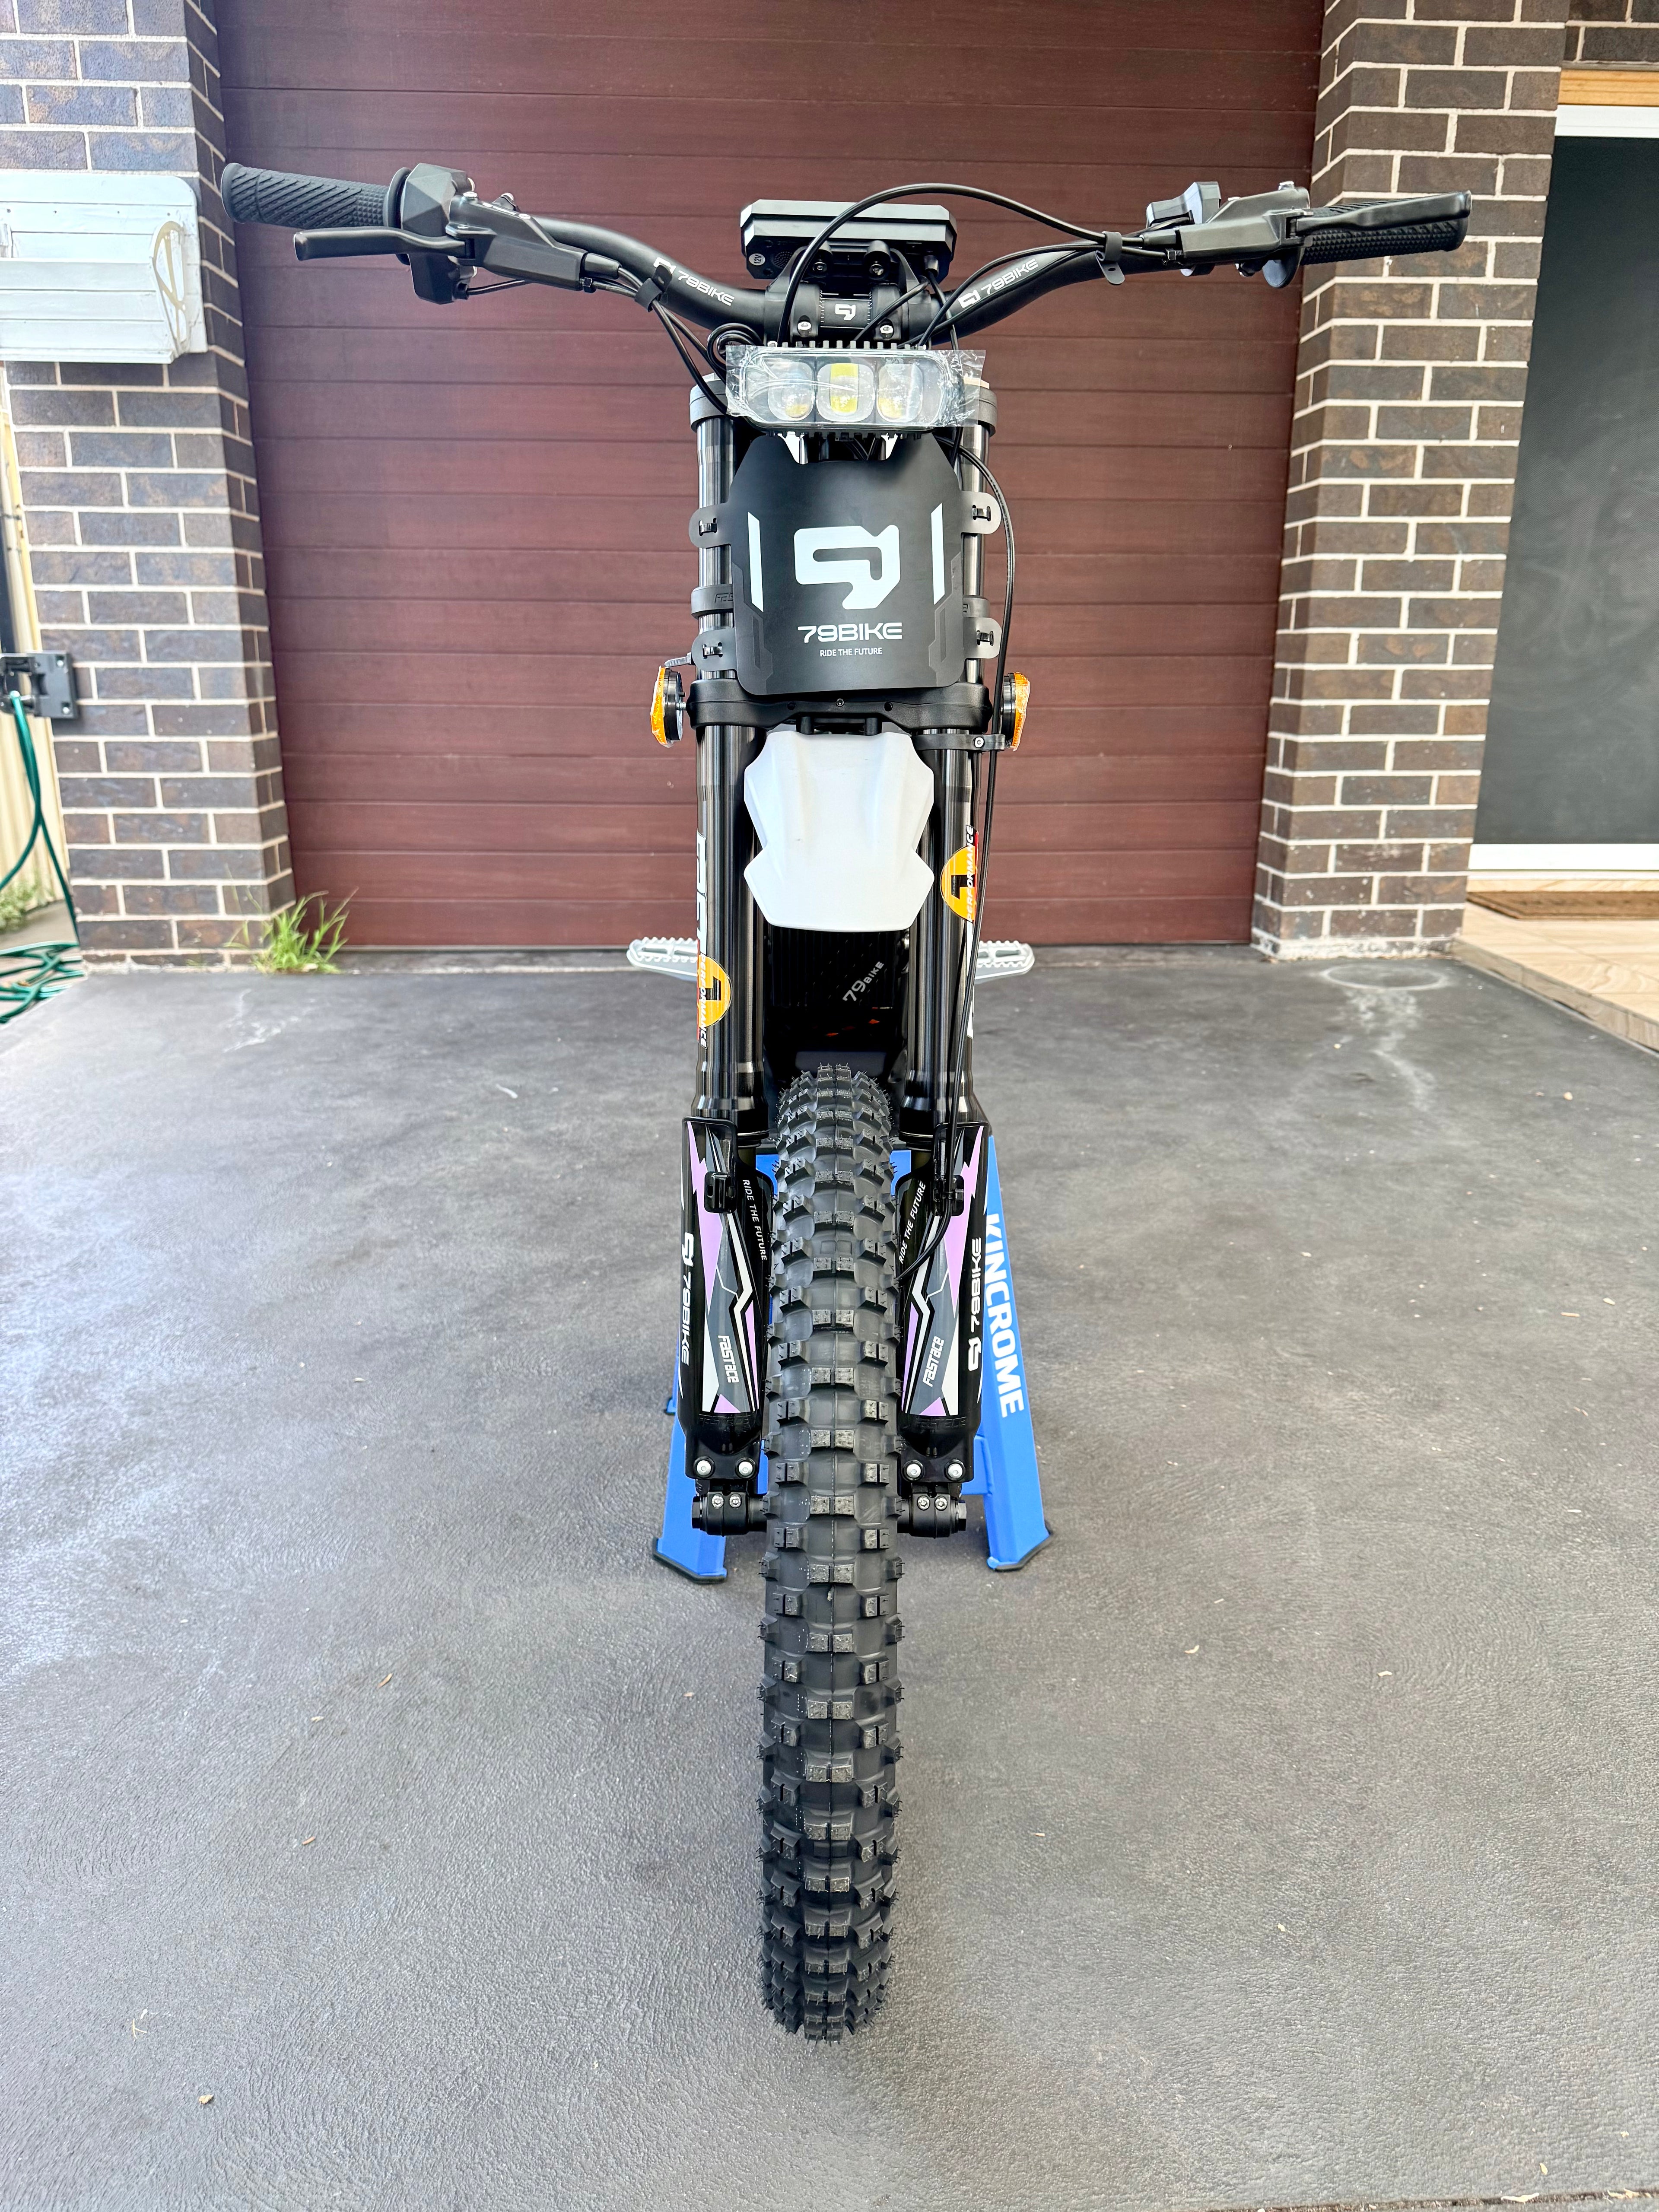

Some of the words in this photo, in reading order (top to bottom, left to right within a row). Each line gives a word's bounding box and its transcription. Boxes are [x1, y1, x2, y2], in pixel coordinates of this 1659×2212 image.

[753, 254, 762, 264] 12V
[981, 258, 1039, 295] 79BIKE
[678, 270, 735, 306] 79BIKE
[798, 622, 903, 643] 79BIKE
[820, 649, 837, 657] RIDE
[838, 648, 853, 656] THE
[854, 647, 883, 656] FUTURE
[842, 961, 884, 1001] 79BIKE
[742, 1179, 754, 1201] RIDE
[749, 1204, 760, 1222] THE
[899, 1239, 908, 1264] RIDE
[904, 1219, 913, 1240] THE
[910, 1180, 926, 1220] FUTURE
[754, 1226, 767, 1261] FUTURE
[971, 1237, 982, 1333] 79BIKE
[681, 1271, 691, 1366] 79BIKE
[985, 1213, 1024, 1418] KINCROME
